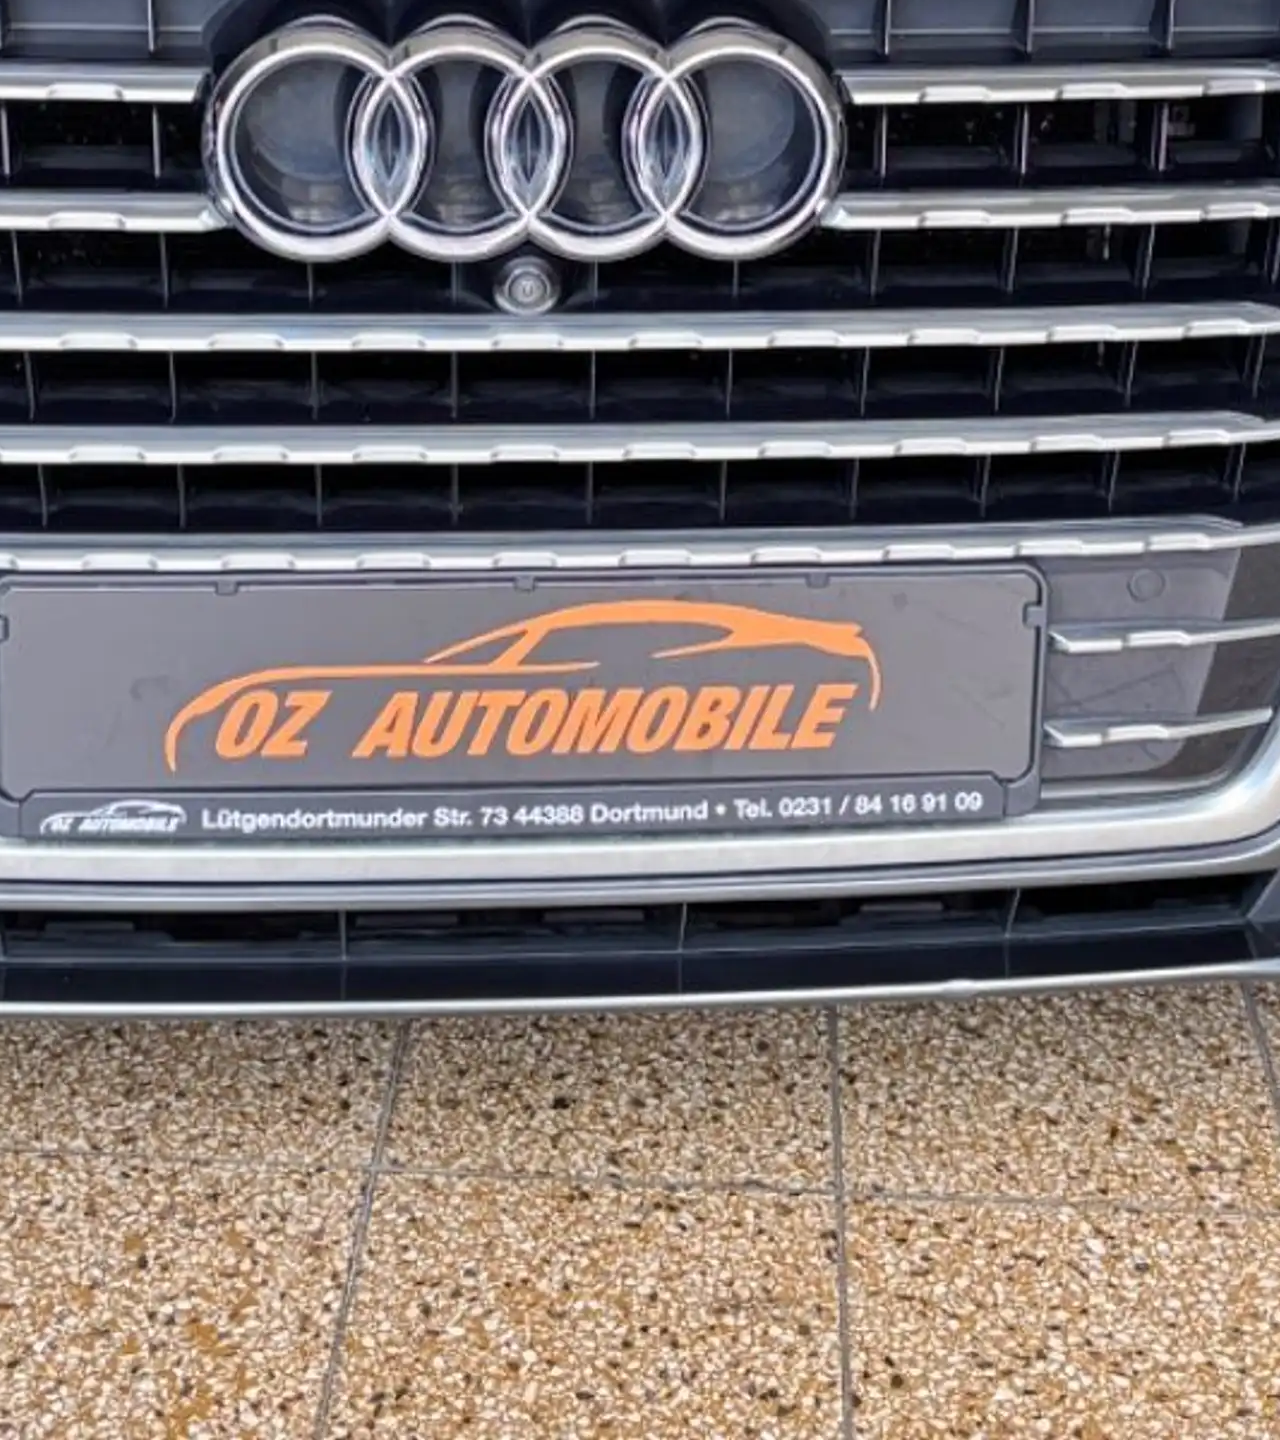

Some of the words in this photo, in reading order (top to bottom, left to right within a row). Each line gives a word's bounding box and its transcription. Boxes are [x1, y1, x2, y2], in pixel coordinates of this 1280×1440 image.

[216, 690, 332, 758] OZ
[352, 683, 858, 758] AUTOMOBILE
[201, 807, 428, 834] Lütgendortmunder
[433, 806, 472, 828] Str.
[480, 805, 509, 827] 73
[513, 803, 584, 826] 44388
[590, 799, 708, 823] Dortmund
[733, 796, 772, 819] Tel.
[778, 795, 832, 817] 0231
[854, 793, 882, 815] 84
